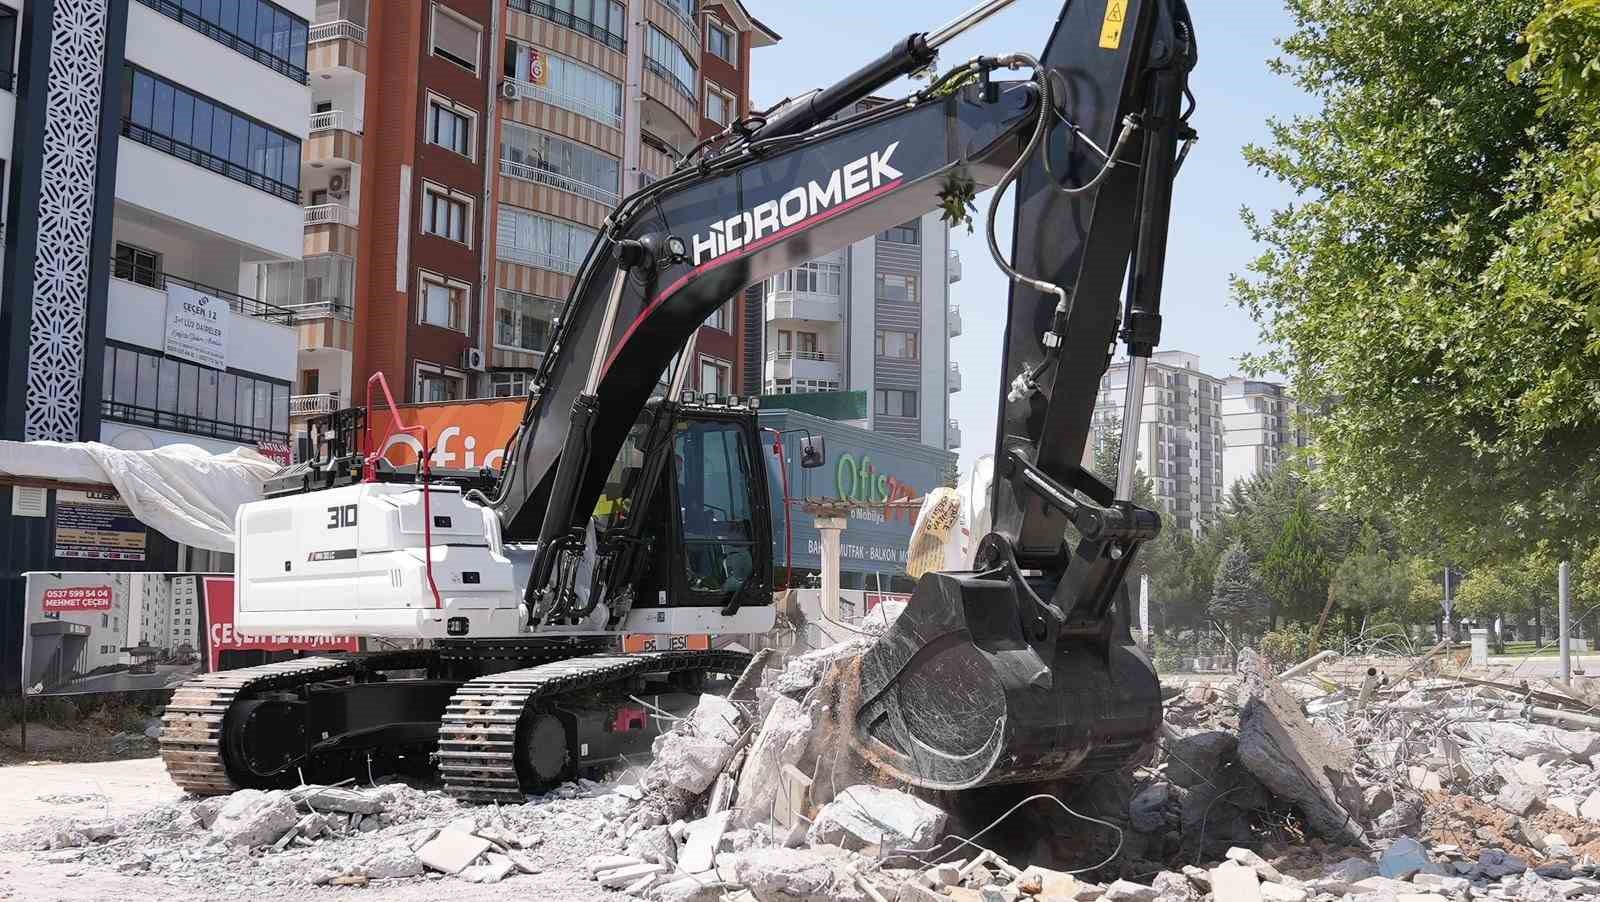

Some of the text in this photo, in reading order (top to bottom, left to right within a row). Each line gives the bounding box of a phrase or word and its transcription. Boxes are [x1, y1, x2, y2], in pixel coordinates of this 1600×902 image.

[208, 310, 217, 320] 12
[327, 504, 358, 529] 310
[870, 547, 896, 561] BALKON
[47, 590, 67, 598] 0537
[81, 598, 108, 607] ÇEÇEN
